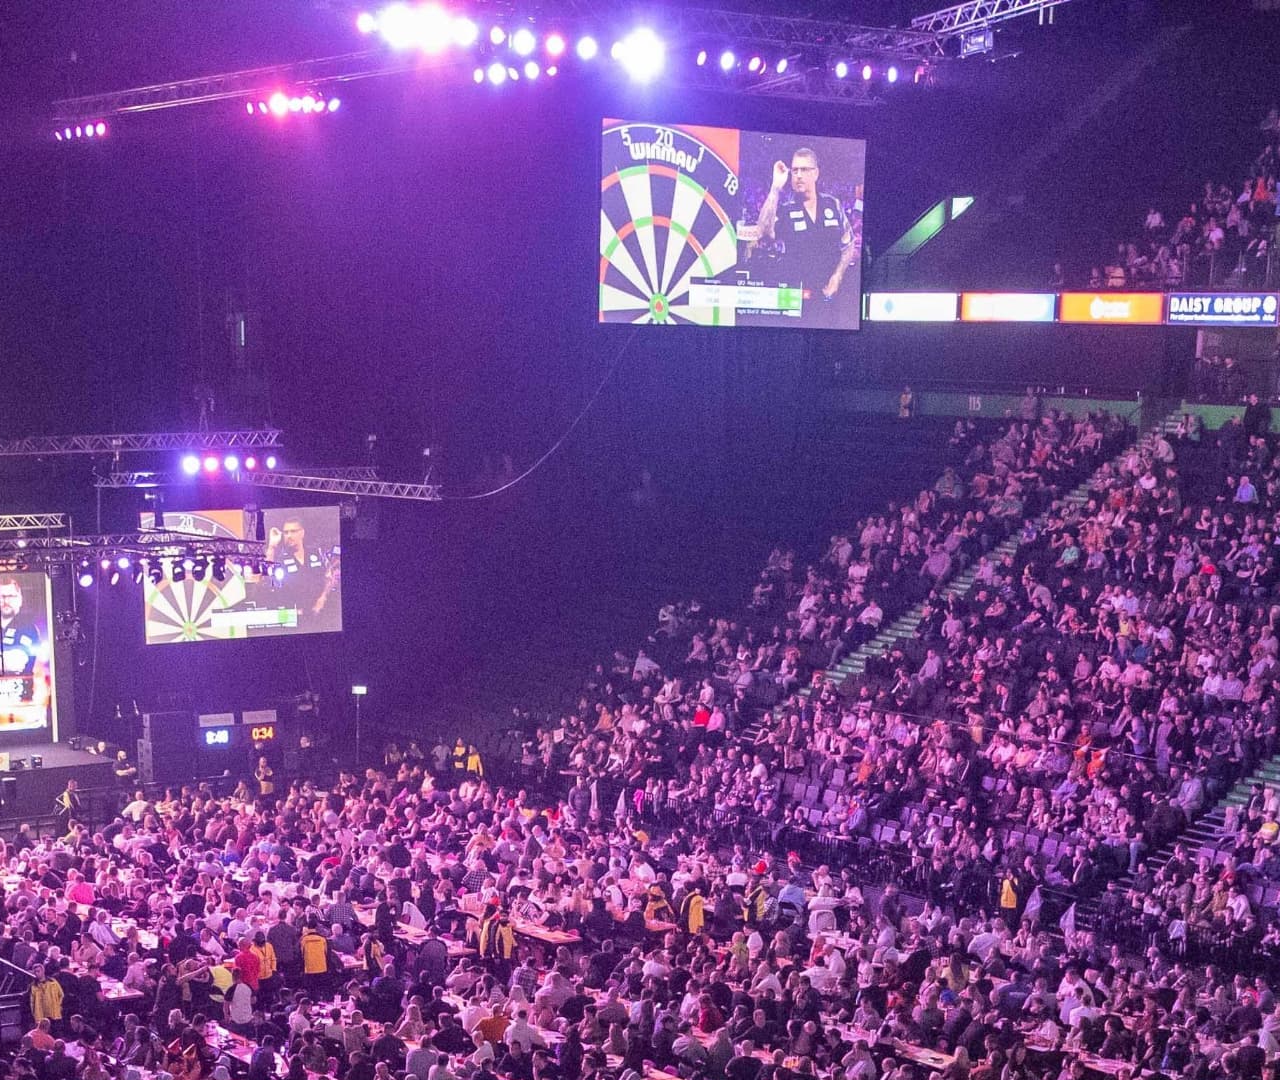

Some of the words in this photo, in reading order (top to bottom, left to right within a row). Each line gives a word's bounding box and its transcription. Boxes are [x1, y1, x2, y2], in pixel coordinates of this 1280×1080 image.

[621, 128, 631, 146] 5
[655, 128, 673, 148] 20
[723, 173, 739, 196] 18
[1170, 296, 1212, 313] DAISY
[1213, 297, 1262, 314] GROUP
